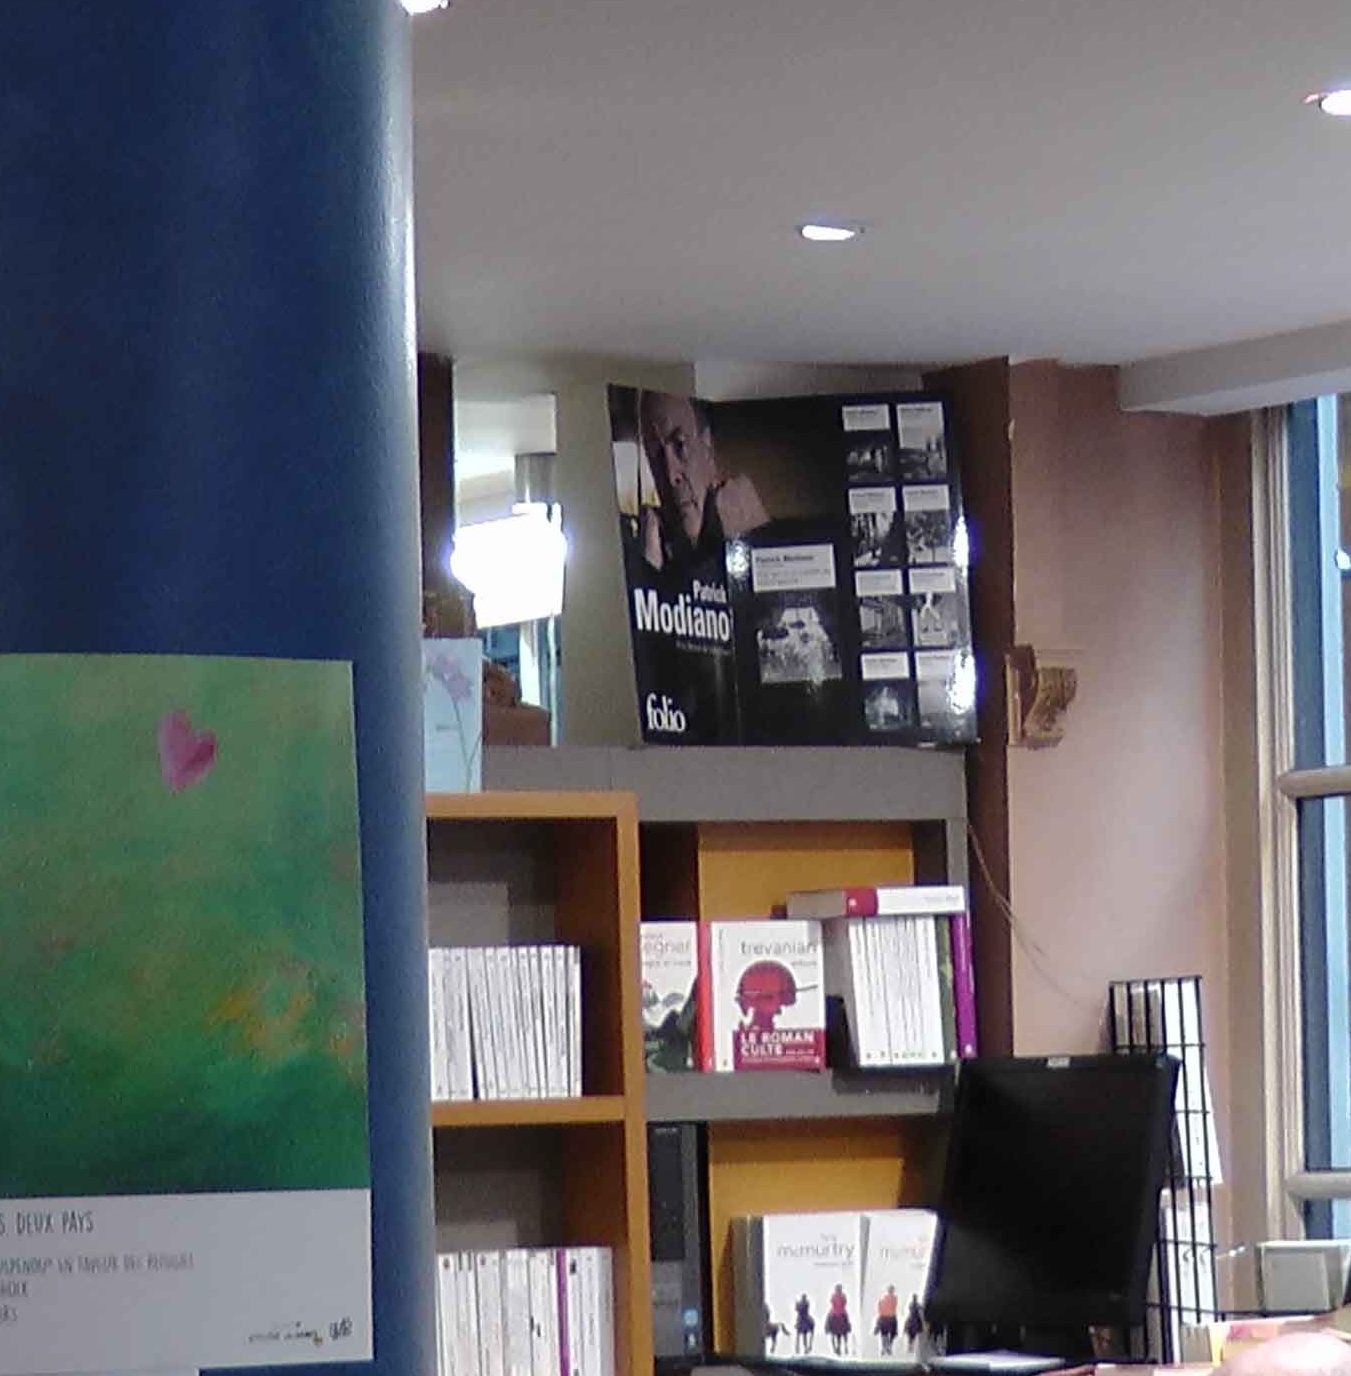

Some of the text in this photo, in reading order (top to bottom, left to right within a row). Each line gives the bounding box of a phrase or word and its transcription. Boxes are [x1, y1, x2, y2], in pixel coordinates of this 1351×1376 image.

[693, 579, 727, 604] Patrick
[634, 588, 731, 642] Modiano
[647, 692, 686, 732] folio
[741, 941, 818, 955] trevanian
[741, 1031, 815, 1043] LE ROMAN
[741, 1044, 783, 1056] CULTE
[16, 1211, 52, 1236] DEUX
[61, 1209, 95, 1233] PAYS
